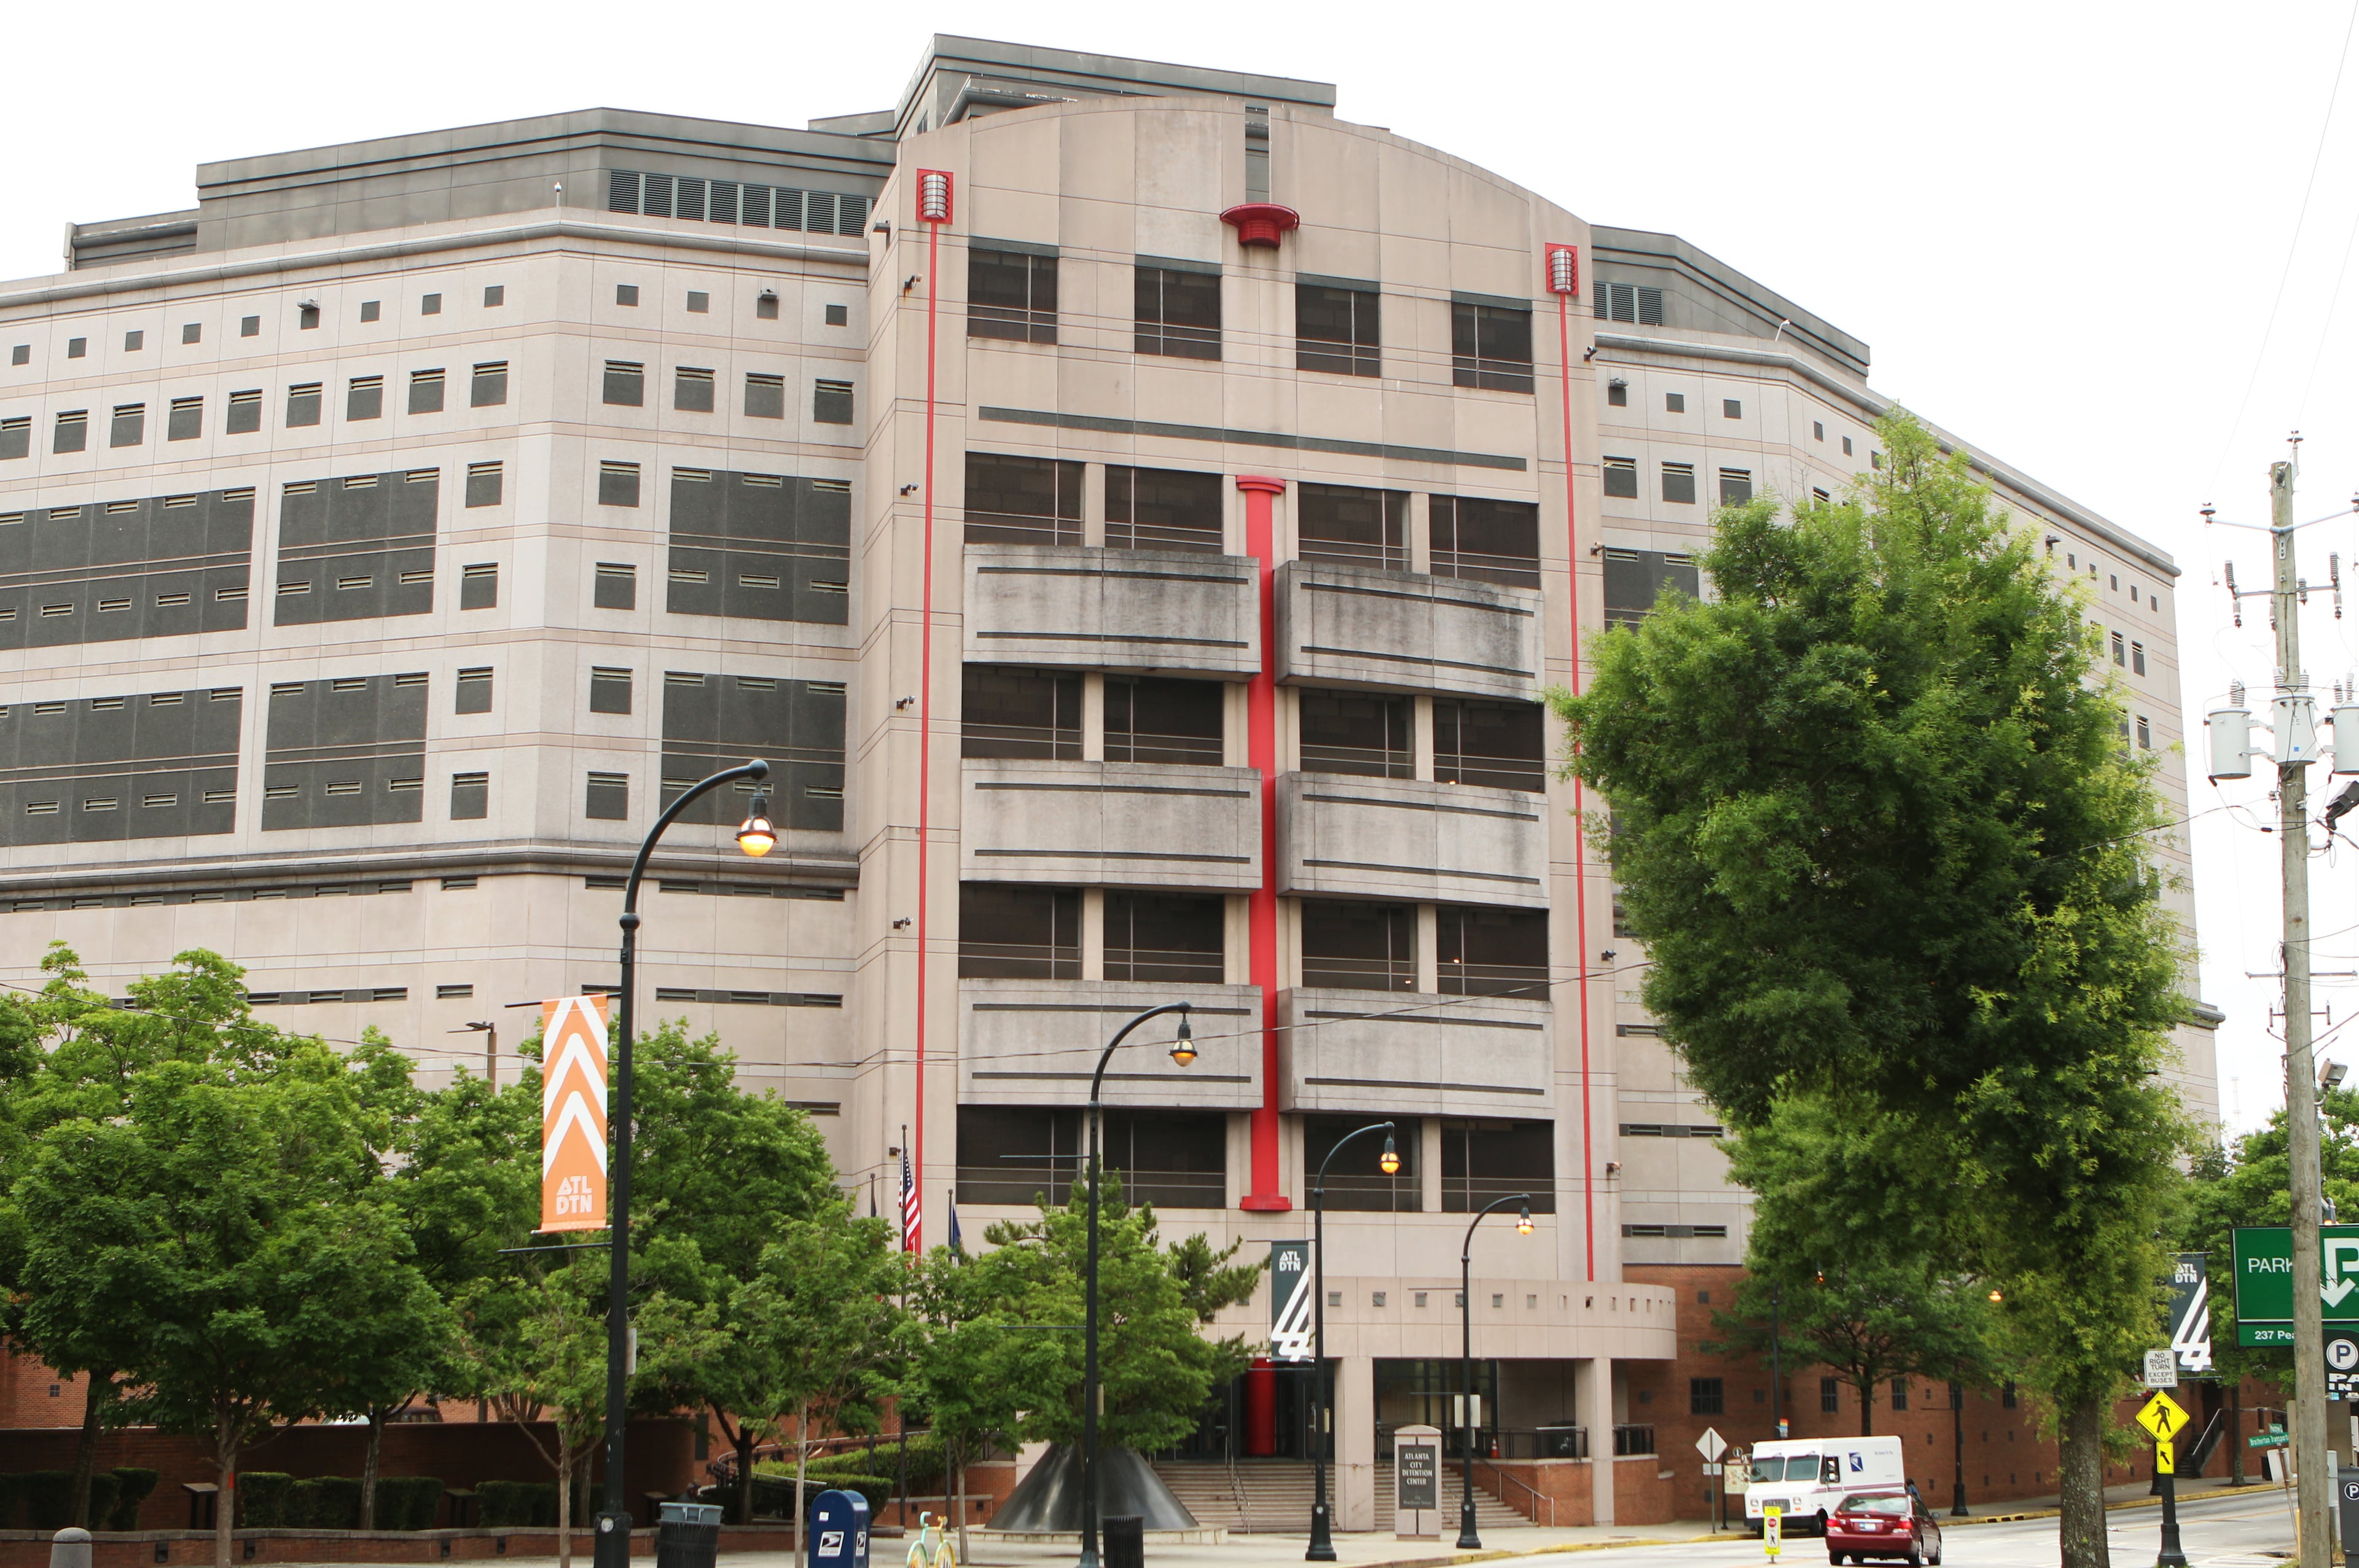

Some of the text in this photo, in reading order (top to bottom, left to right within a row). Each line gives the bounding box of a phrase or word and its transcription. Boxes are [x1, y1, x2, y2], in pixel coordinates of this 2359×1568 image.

[556, 1176, 593, 1195] ATL
[556, 1194, 592, 1215] DTN
[1279, 1250, 1301, 1261] ATL
[1279, 1261, 1301, 1271] DTN
[2175, 1273, 2197, 1284] DTN
[2255, 1331, 2274, 1340] 237
[2336, 1344, 2350, 1363] P
[2328, 1383, 2352, 1391] IN
[2270, 1434, 2289, 1443] Transport
[1402, 1469, 1433, 1477] DETENTION
[2349, 1485, 2359, 1497] P
